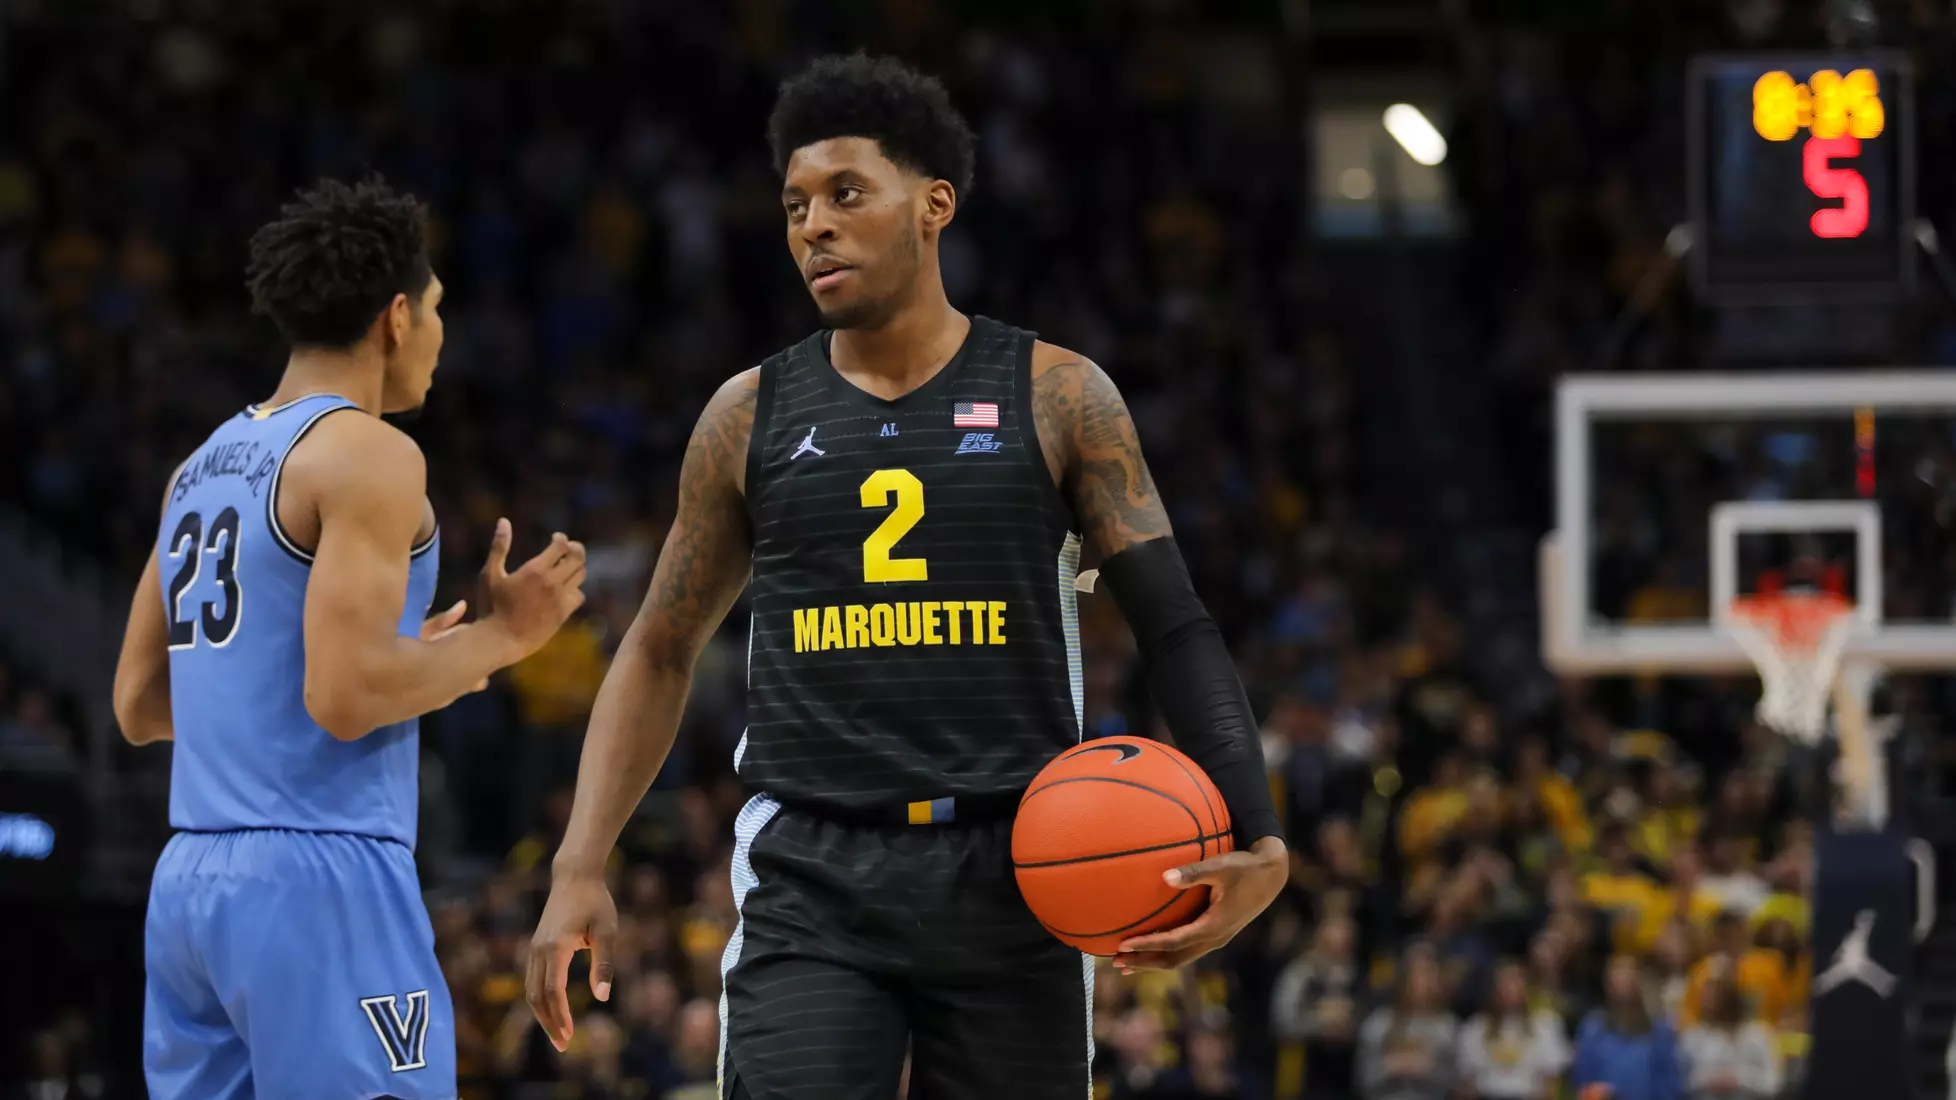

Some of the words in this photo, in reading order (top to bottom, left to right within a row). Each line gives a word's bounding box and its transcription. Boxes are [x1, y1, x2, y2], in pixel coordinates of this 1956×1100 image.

[1802, 134, 1869, 238] 5
[879, 423, 899, 437] AL
[957, 442, 1004, 450] EAST
[962, 433, 995, 442] BIG
[174, 441, 260, 502] SAMUELS
[860, 468, 928, 582] 2
[167, 506, 243, 651] 23
[793, 601, 1007, 653] MARQUETTE
[360, 989, 429, 1072] V
